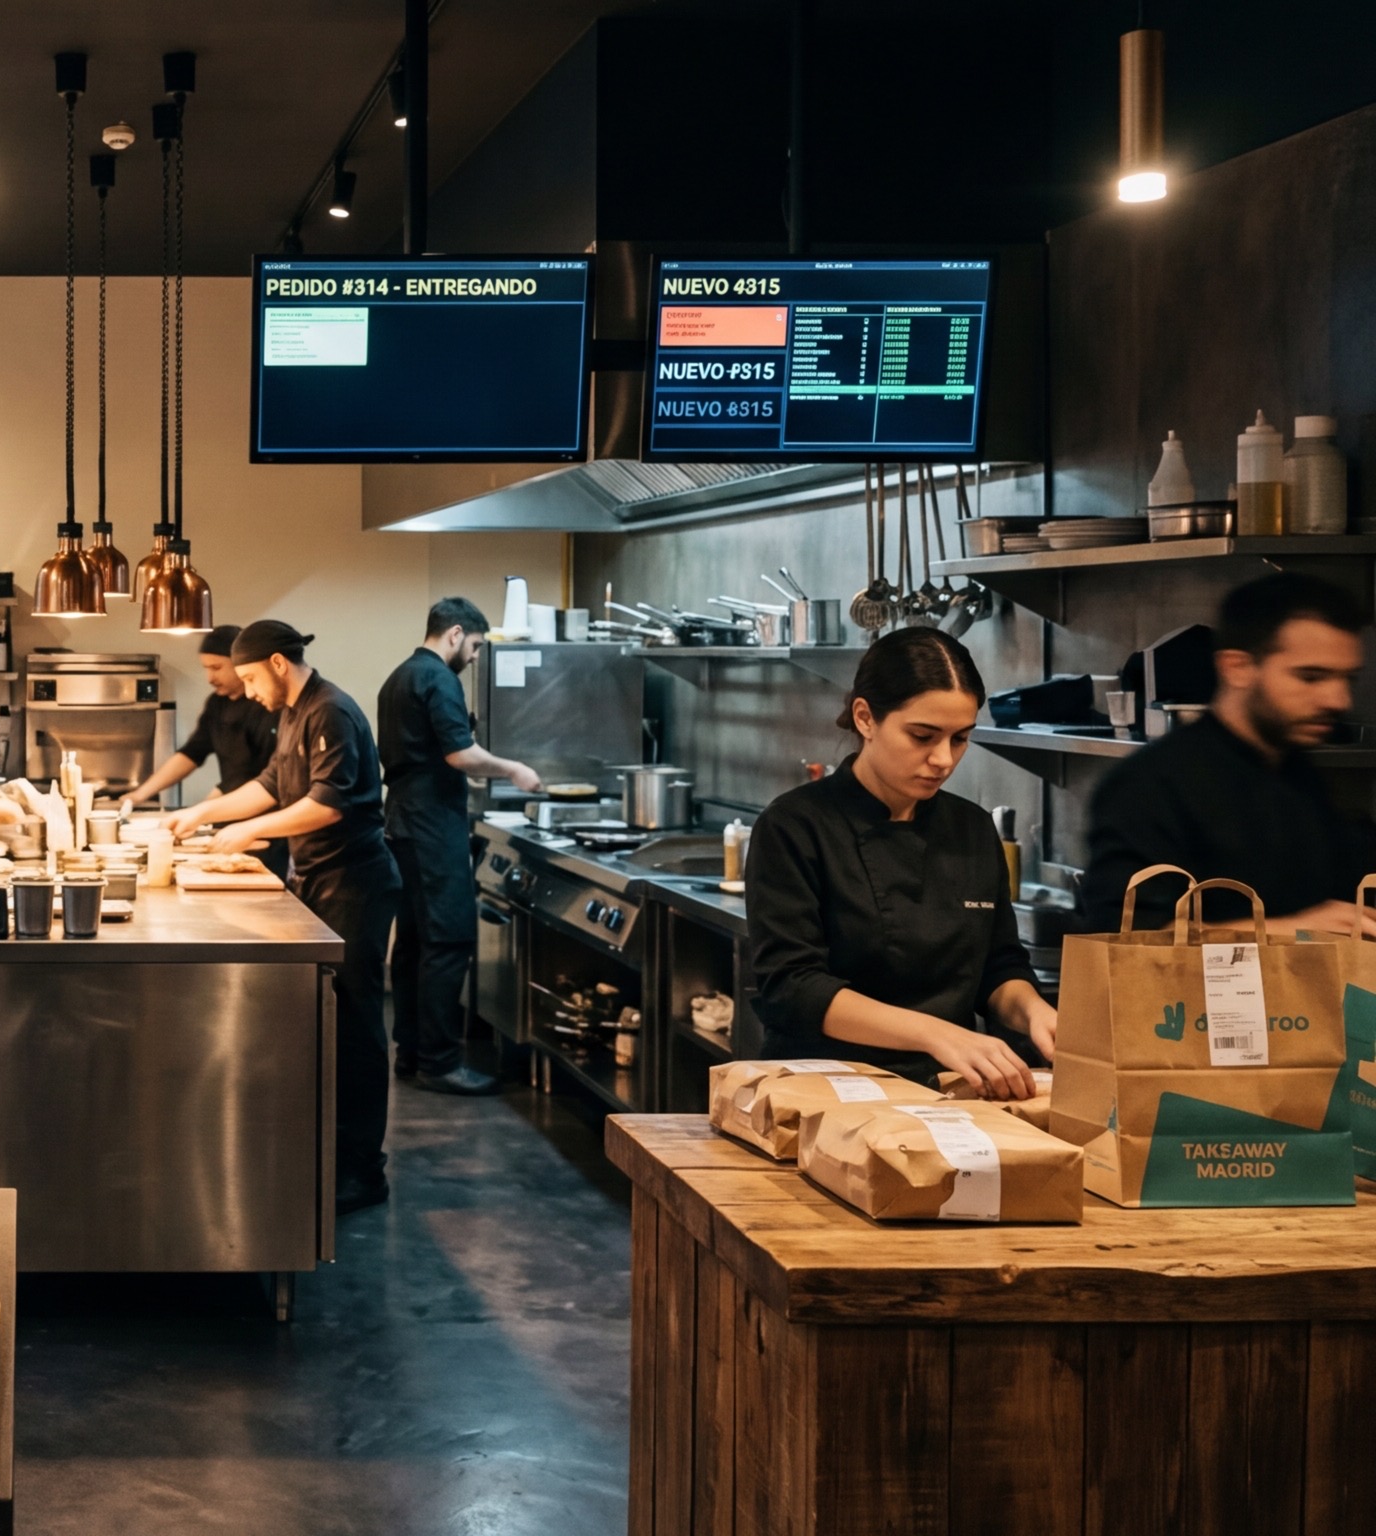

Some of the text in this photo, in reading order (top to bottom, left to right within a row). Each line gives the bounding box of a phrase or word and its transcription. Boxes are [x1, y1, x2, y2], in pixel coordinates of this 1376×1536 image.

[265, 278, 337, 296] PEDIDO
[342, 278, 389, 296] #314
[406, 278, 537, 296] ENTREGANDO
[663, 278, 729, 296] NUEVO
[659, 362, 724, 380] NUEVO
[657, 401, 722, 418] NUEVO
